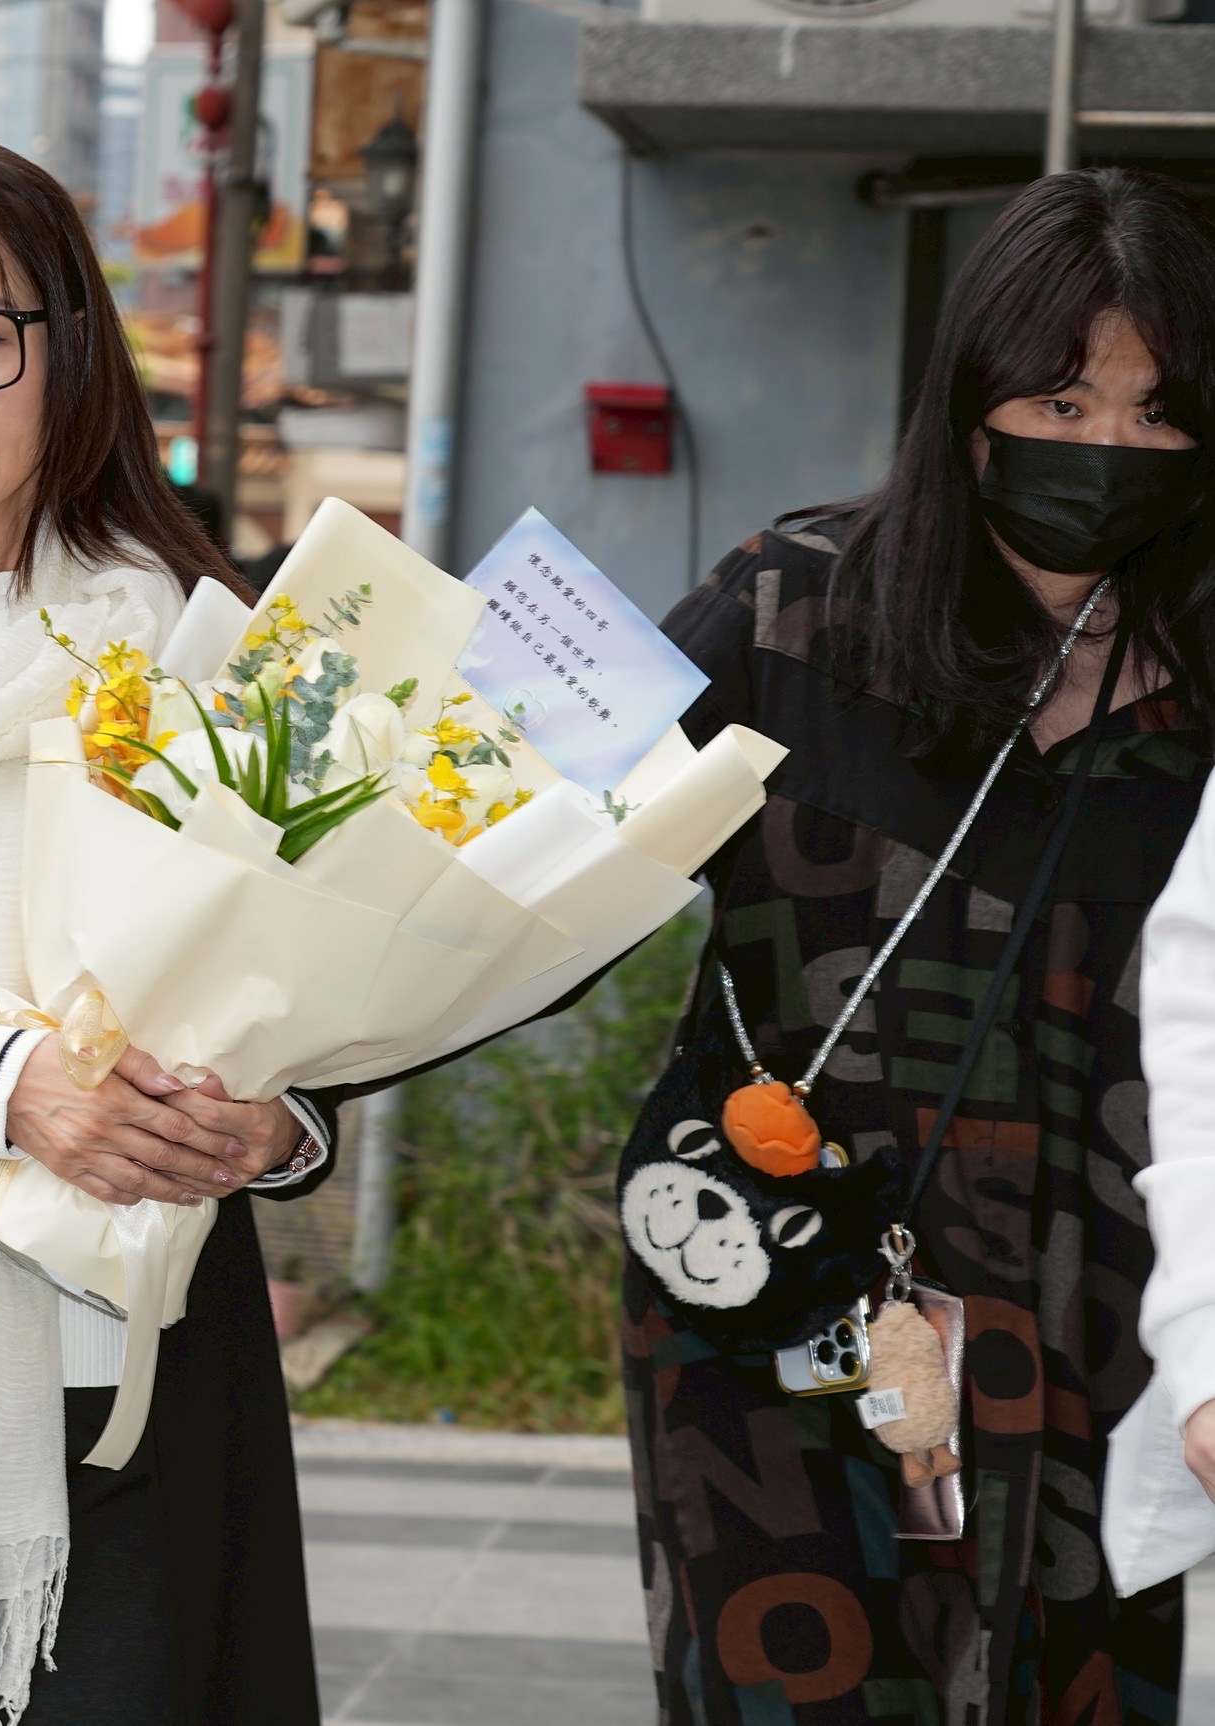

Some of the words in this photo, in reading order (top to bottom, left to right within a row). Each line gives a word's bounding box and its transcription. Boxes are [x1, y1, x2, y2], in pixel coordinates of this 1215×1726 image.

[527, 552, 609, 632] 懷念親愛的四哥
